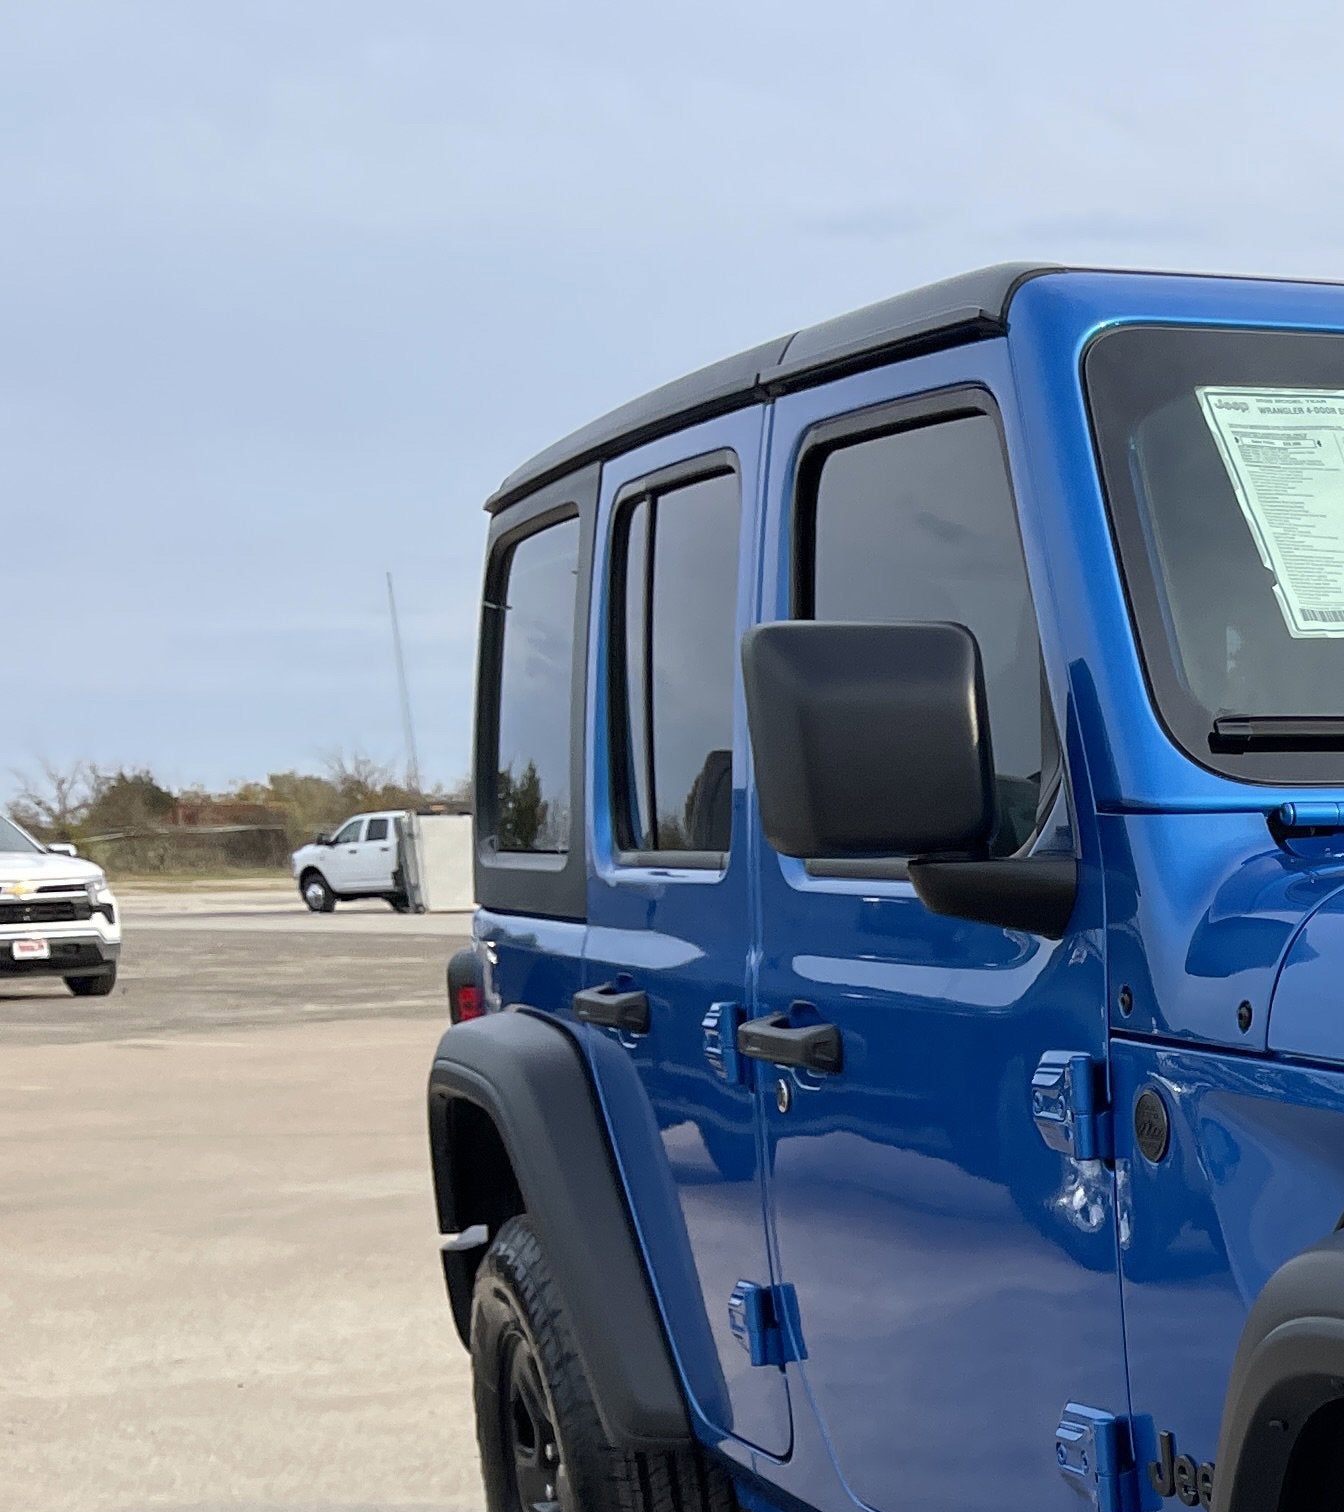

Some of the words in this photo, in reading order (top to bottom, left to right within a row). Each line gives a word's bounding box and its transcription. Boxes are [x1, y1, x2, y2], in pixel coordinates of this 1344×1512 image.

[1214, 399, 1249, 413] Jeep
[1258, 407, 1304, 416] WRANGLER
[1149, 1429, 1216, 1512] Jee
